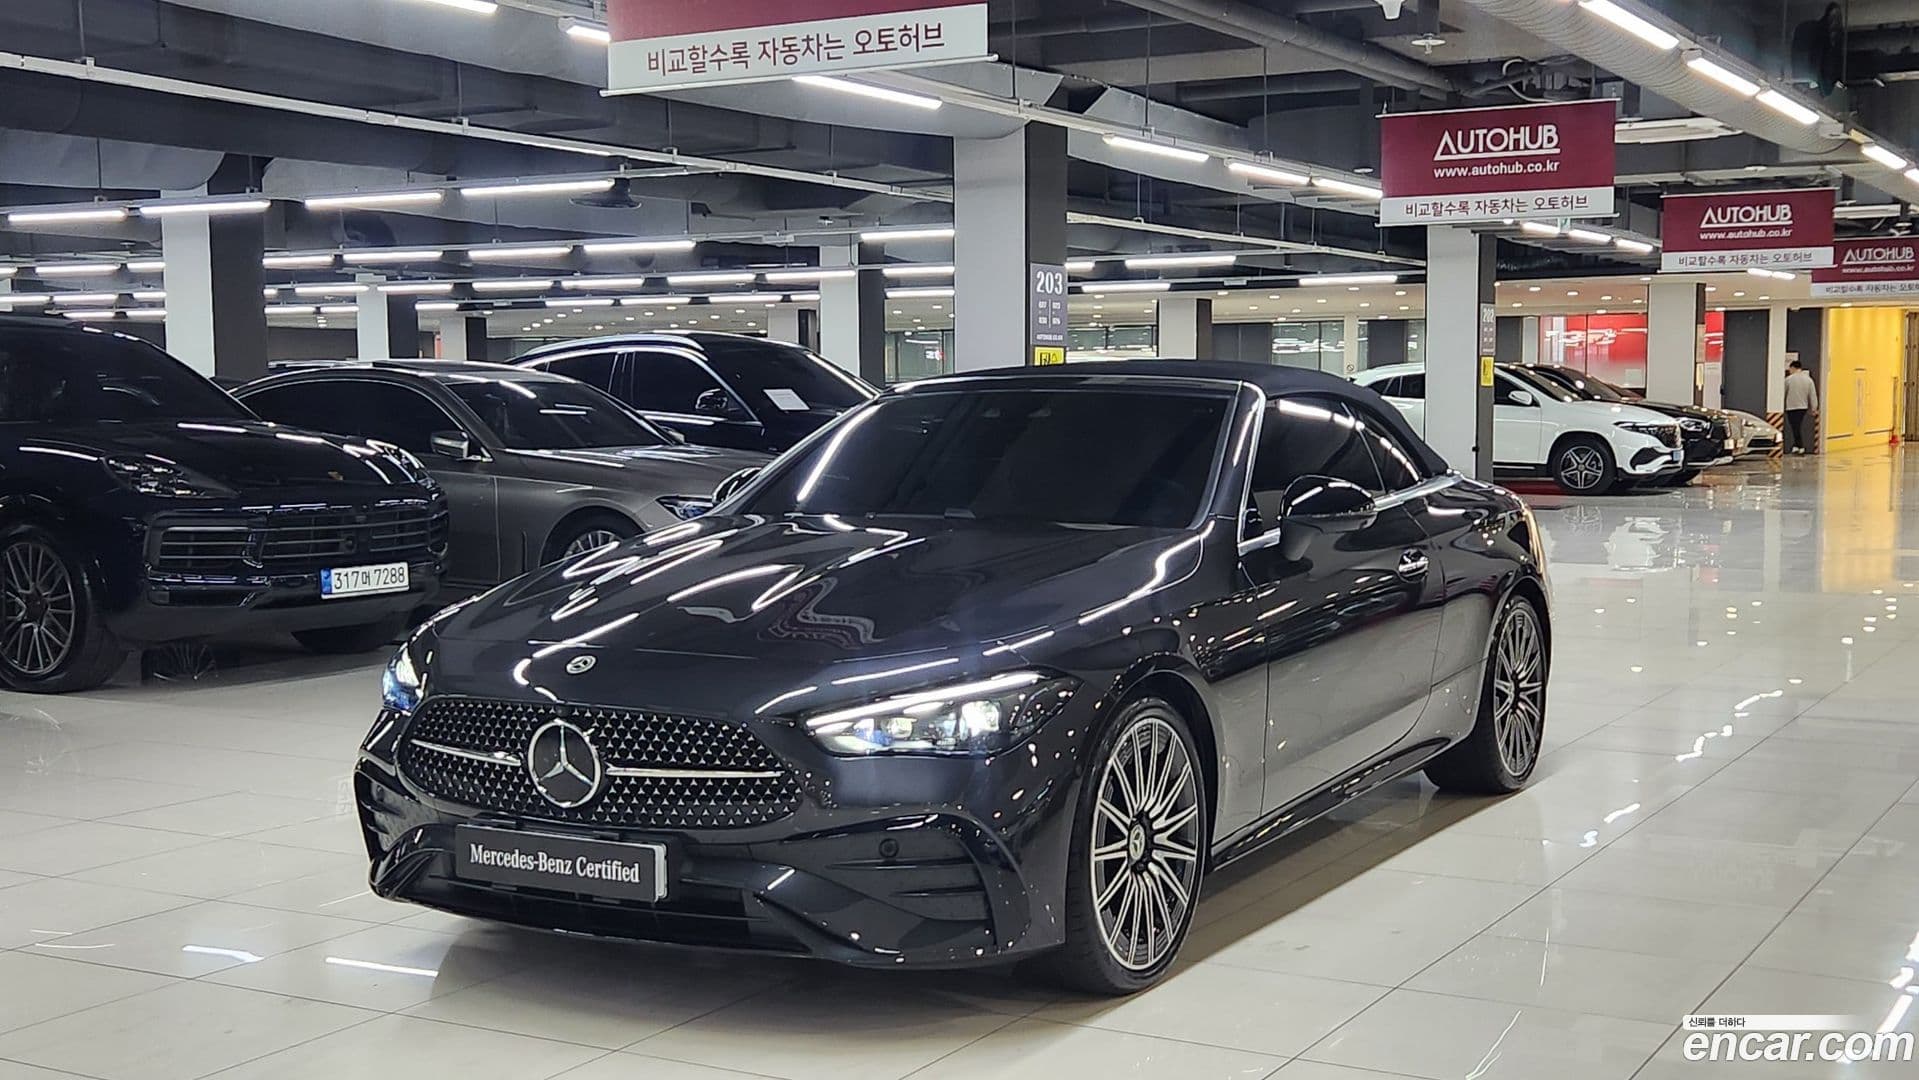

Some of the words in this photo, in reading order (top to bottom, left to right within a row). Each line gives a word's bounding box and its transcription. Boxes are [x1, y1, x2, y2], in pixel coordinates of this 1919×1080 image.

[647, 42, 751, 77] 비교할수록
[757, 33, 845, 67] 자동차는
[852, 22, 945, 56] 오토허브
[1433, 124, 1560, 160] AUTOHUB
[1433, 160, 1560, 179] www.autohub.co.kr
[1405, 201, 1470, 217] 비교할수록
[1474, 198, 1529, 215] 자동차는
[1533, 195, 1589, 211] 오토허브
[1700, 204, 1793, 228] AUTOHUB
[1700, 228, 1792, 240] www.autohub.co.kr
[1842, 247, 1915, 264] AUTOHUB
[1036, 271, 1063, 295] 203
[469, 843, 572, 875] Mercedes-Benz
[575, 856, 640, 883] Certified
